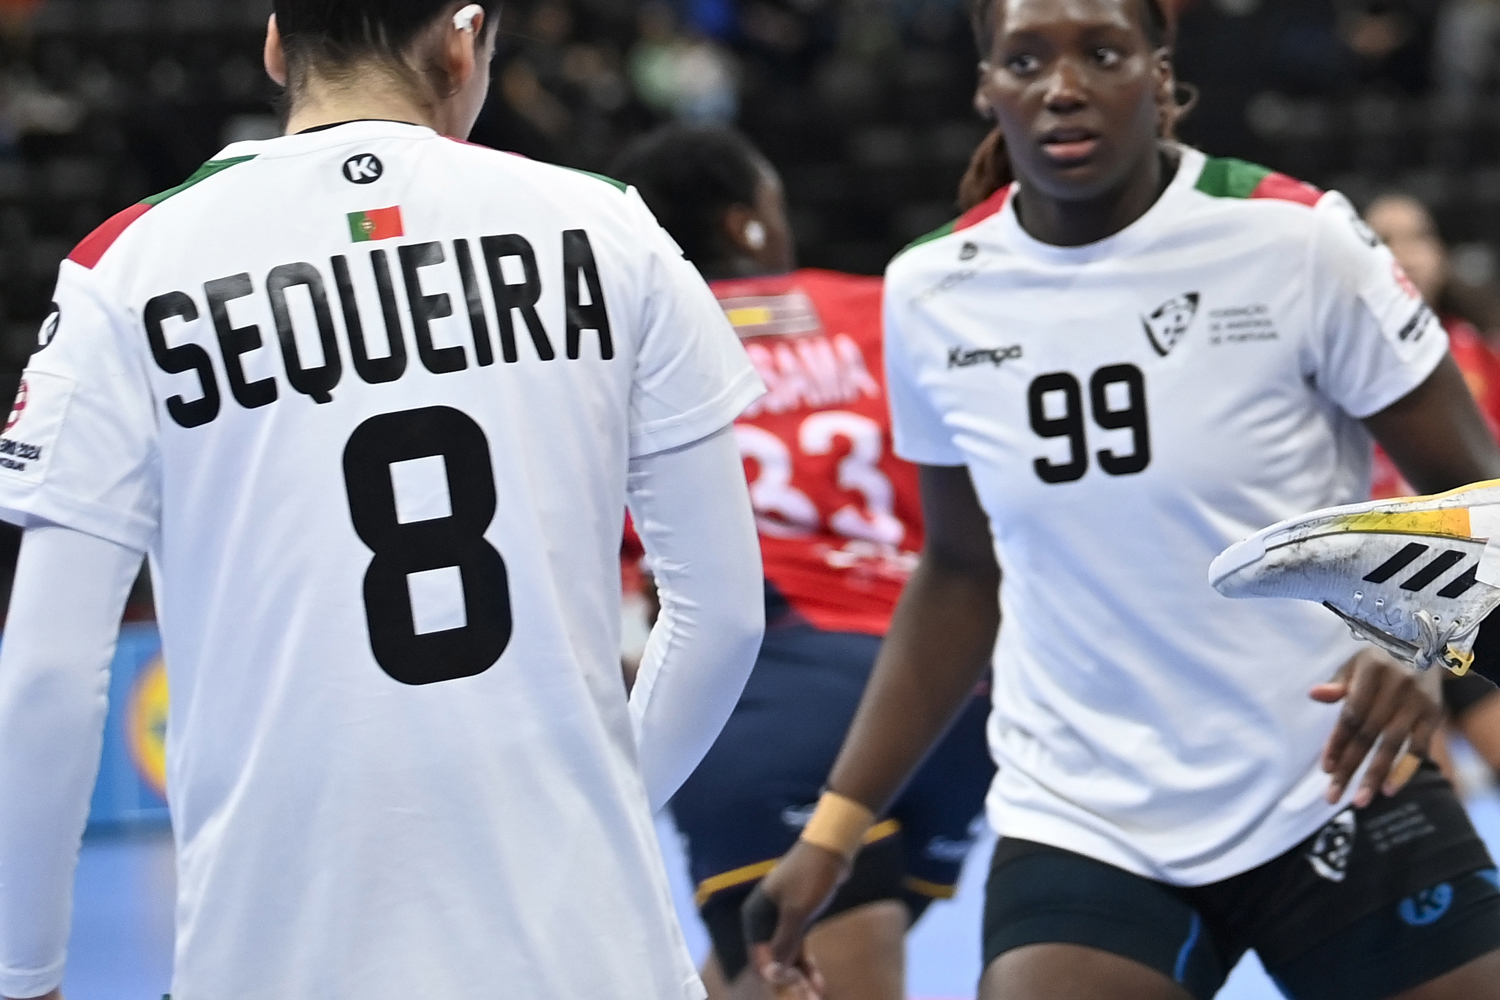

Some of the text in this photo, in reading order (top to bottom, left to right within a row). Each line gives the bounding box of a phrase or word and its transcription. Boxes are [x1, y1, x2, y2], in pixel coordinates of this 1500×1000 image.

[143, 229, 615, 429] SEQUEIRA
[948, 344, 1023, 369] Kempa
[1027, 362, 1152, 485] 99
[342, 405, 514, 686] 8
